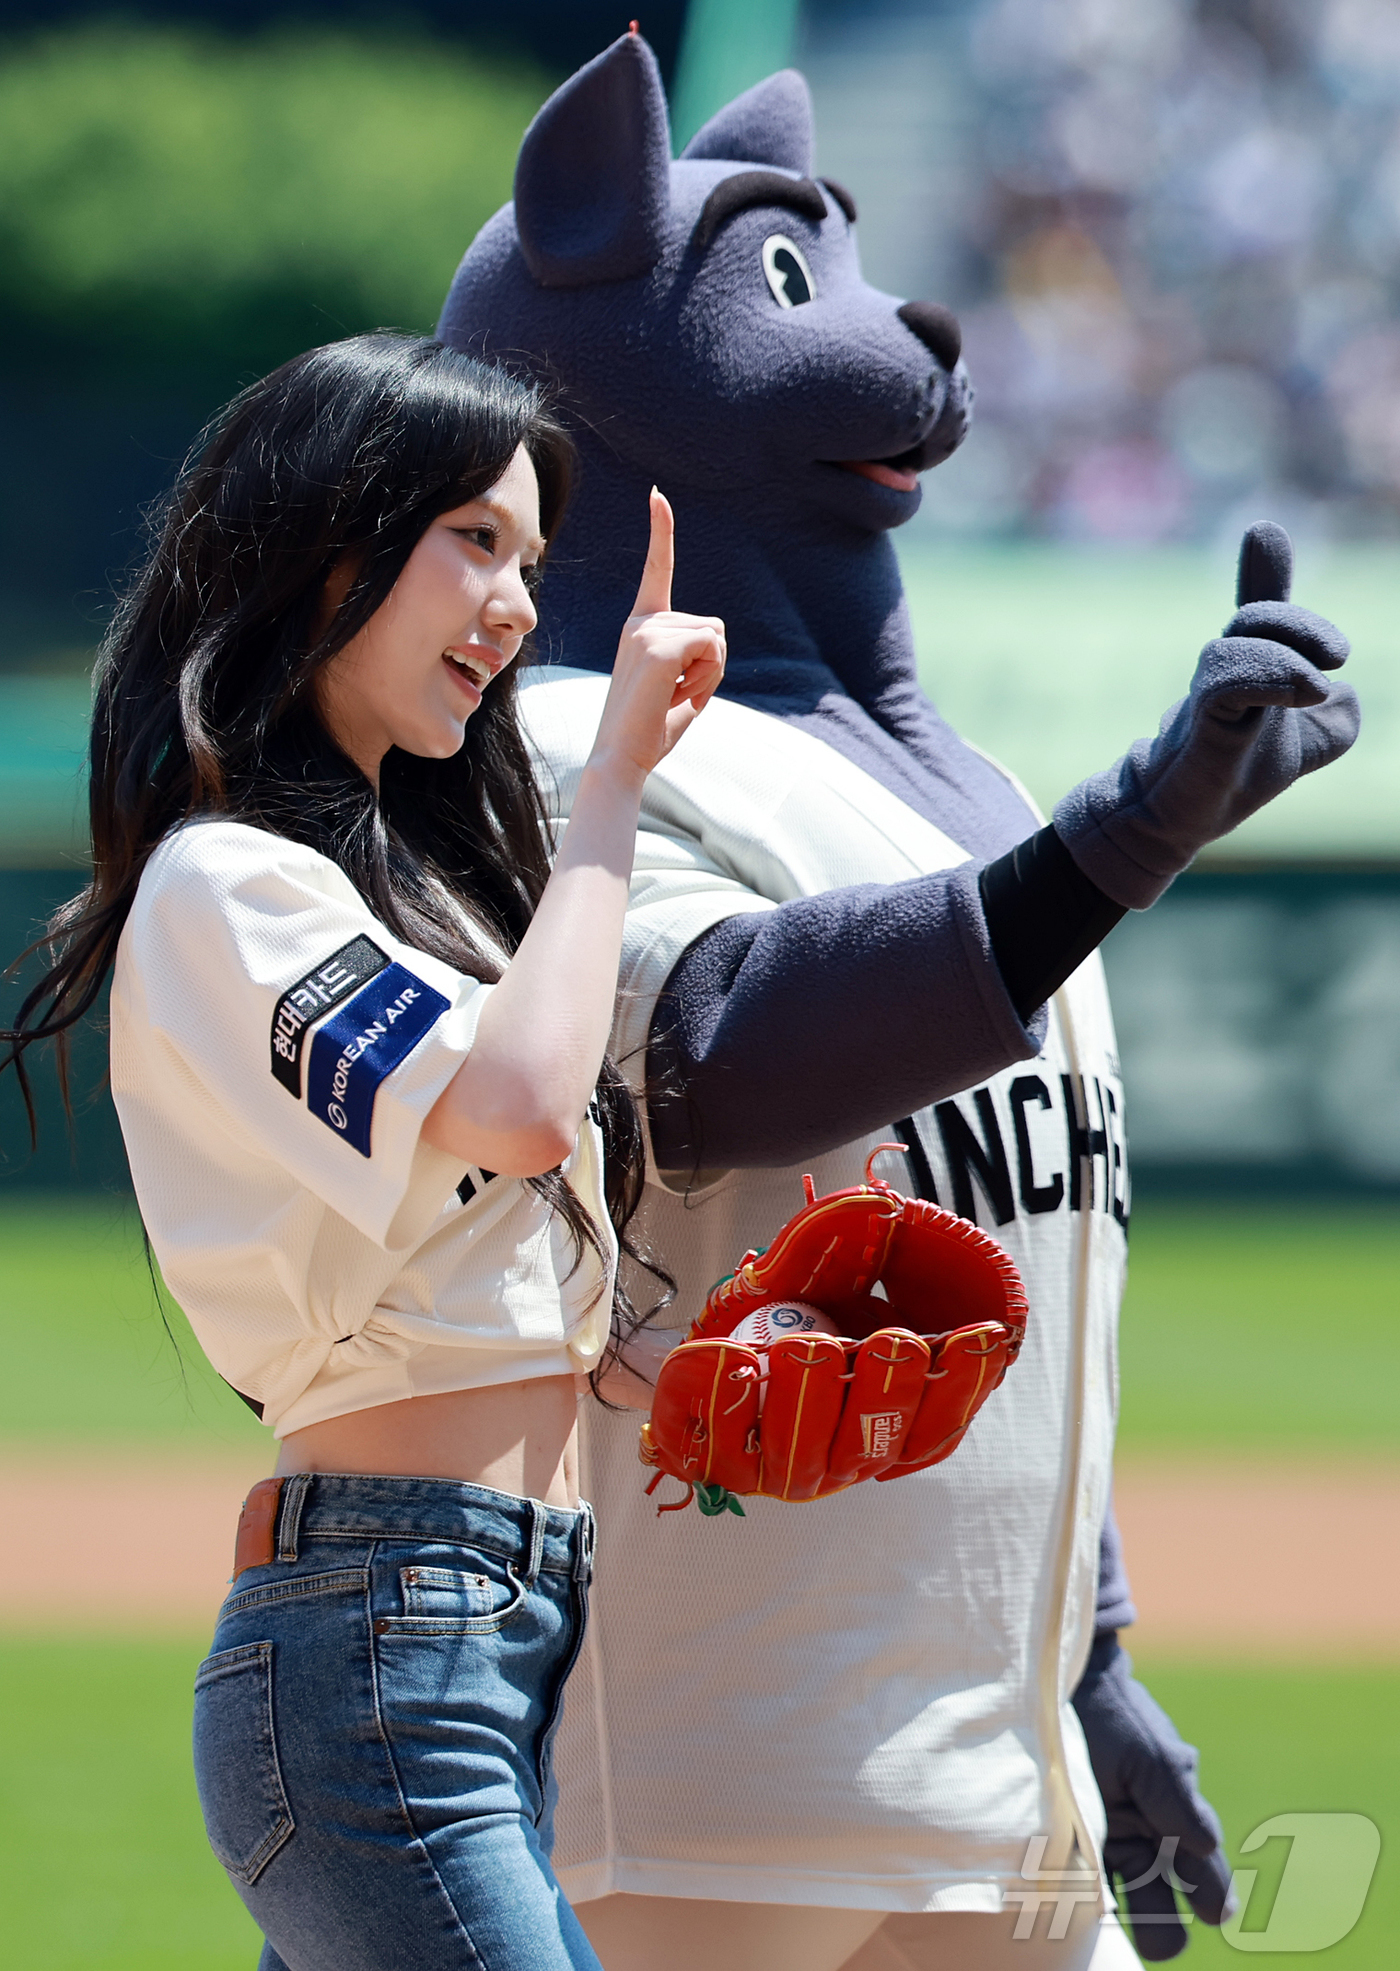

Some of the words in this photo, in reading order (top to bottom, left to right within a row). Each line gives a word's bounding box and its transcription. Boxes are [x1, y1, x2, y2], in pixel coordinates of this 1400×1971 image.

[273, 961, 357, 1062] 현대카드
[331, 1020, 387, 1103] KOREAN
[384, 987, 421, 1024] AIR
[800, 1315, 816, 1332] KBO
